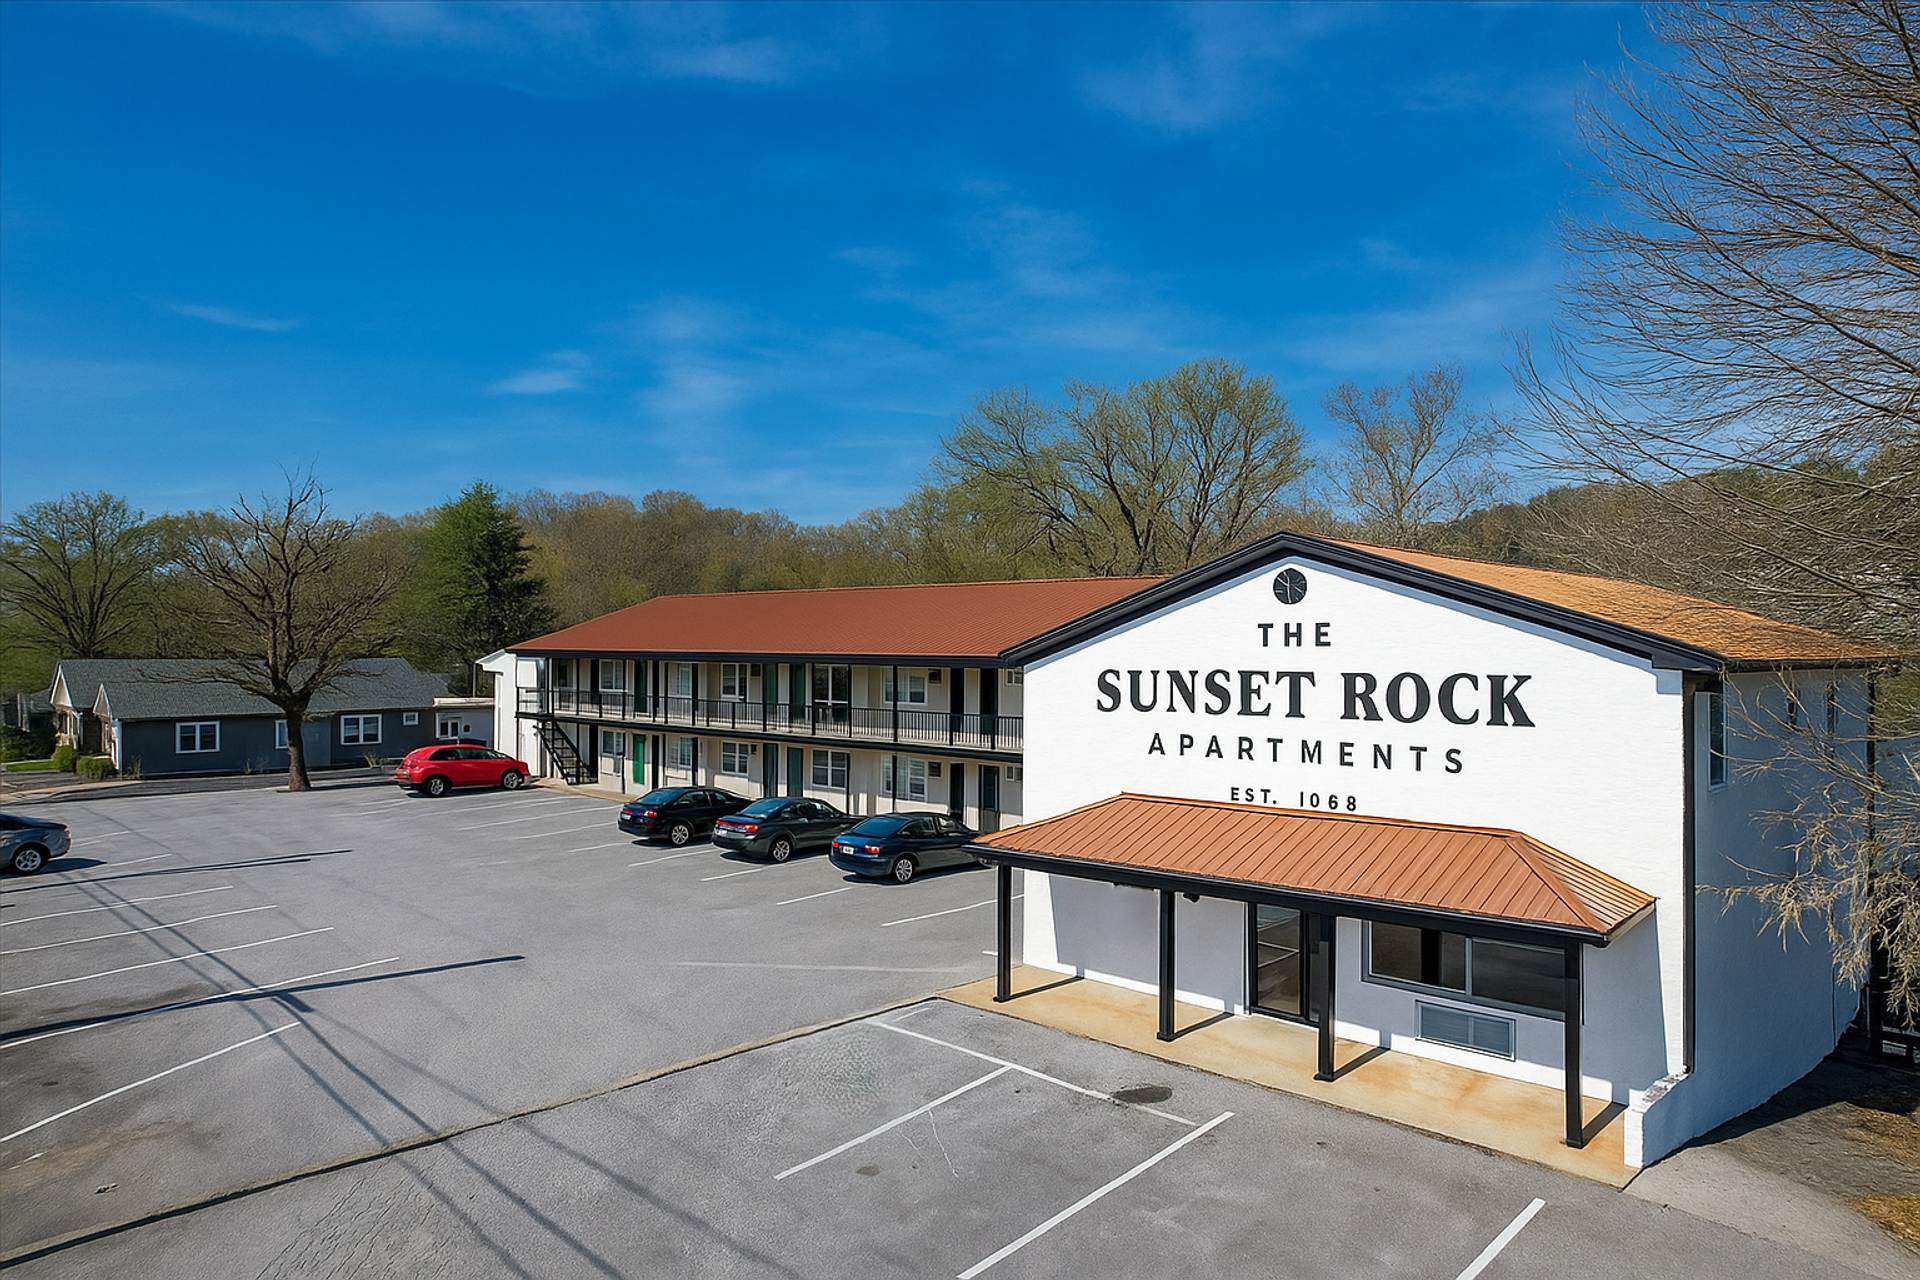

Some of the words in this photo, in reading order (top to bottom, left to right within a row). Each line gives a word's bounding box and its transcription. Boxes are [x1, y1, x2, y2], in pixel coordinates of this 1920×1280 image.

[1257, 622, 1332, 647] THE
[1096, 668, 1316, 719] SUNSET
[1340, 672, 1536, 728] ROCK
[1147, 732, 1464, 774] APARTMENTS
[1230, 786, 1279, 805] EST.
